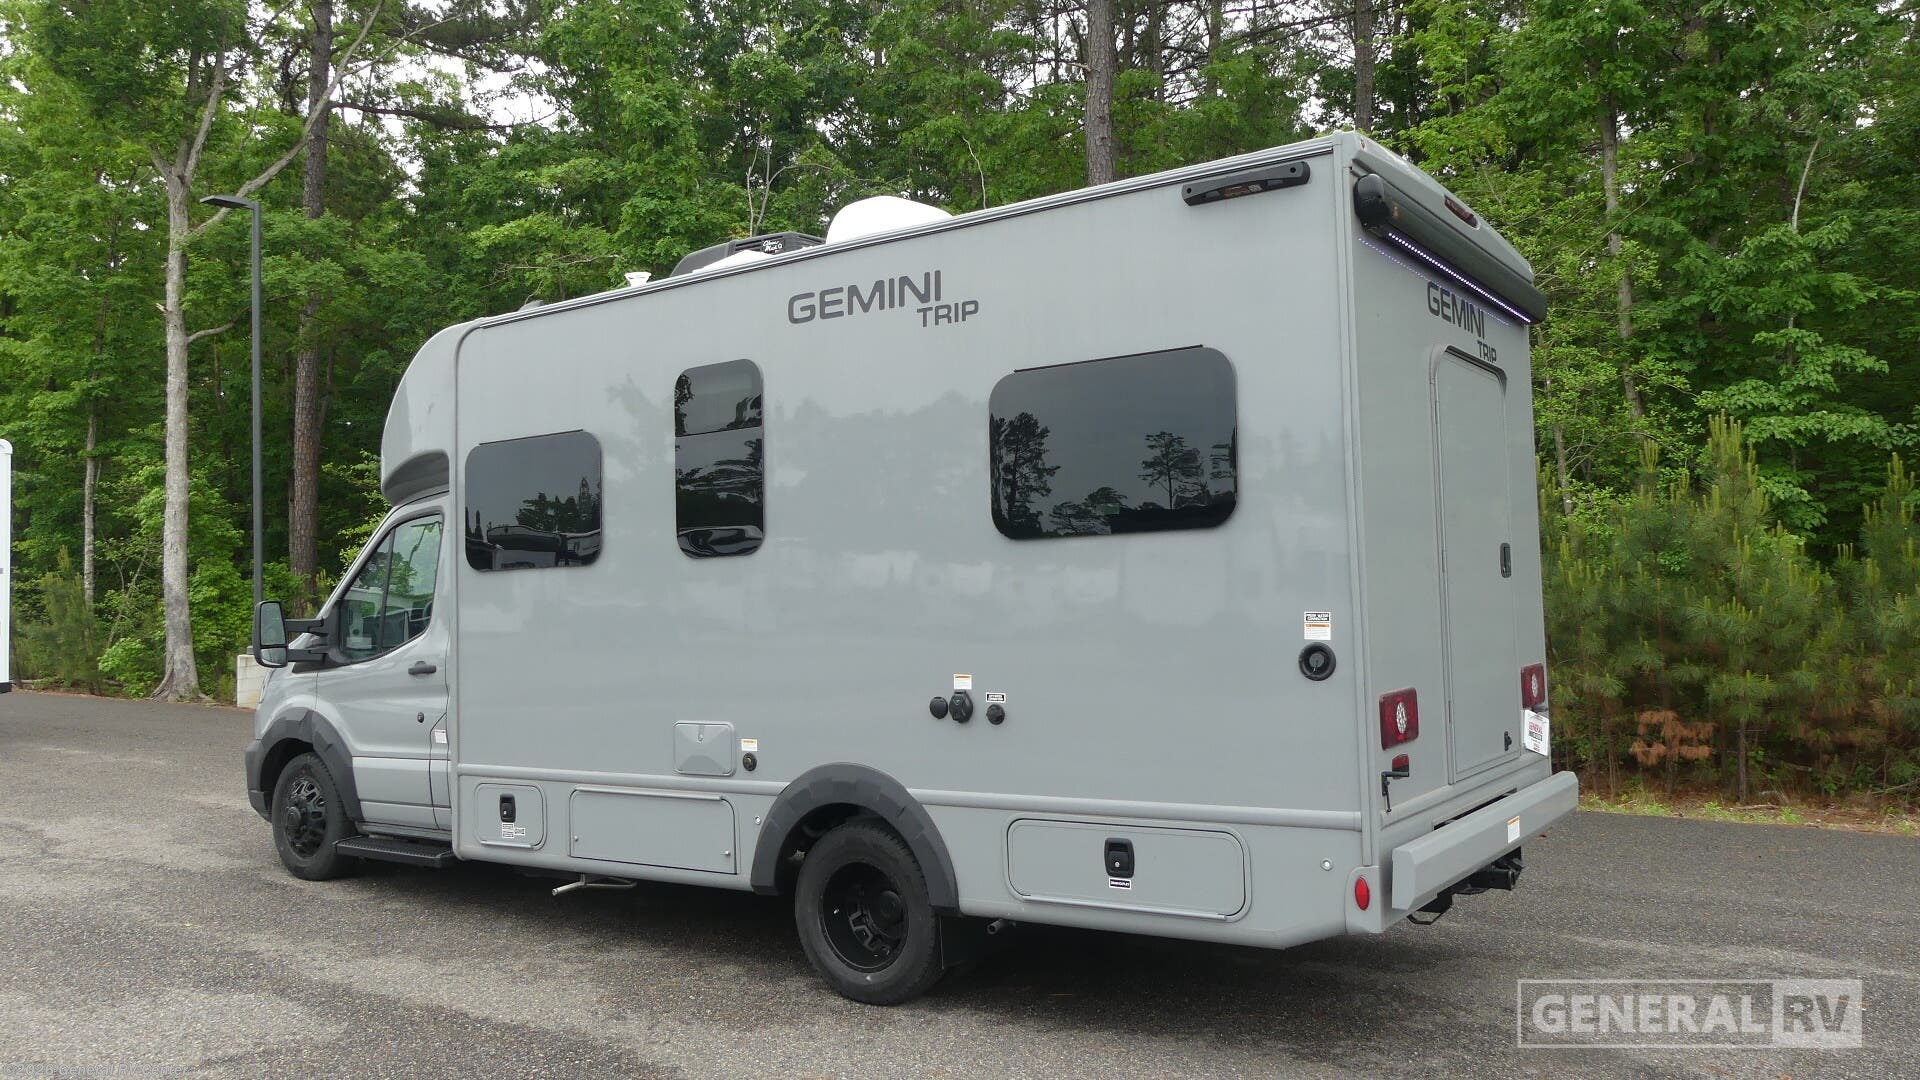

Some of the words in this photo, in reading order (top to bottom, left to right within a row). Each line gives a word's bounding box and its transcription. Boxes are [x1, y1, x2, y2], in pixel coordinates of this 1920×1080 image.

[788, 270, 941, 324] GEMINI
[916, 300, 979, 328] TRIP
[1428, 281, 1485, 339] GEMINI
[1477, 340, 1497, 363] TRIP
